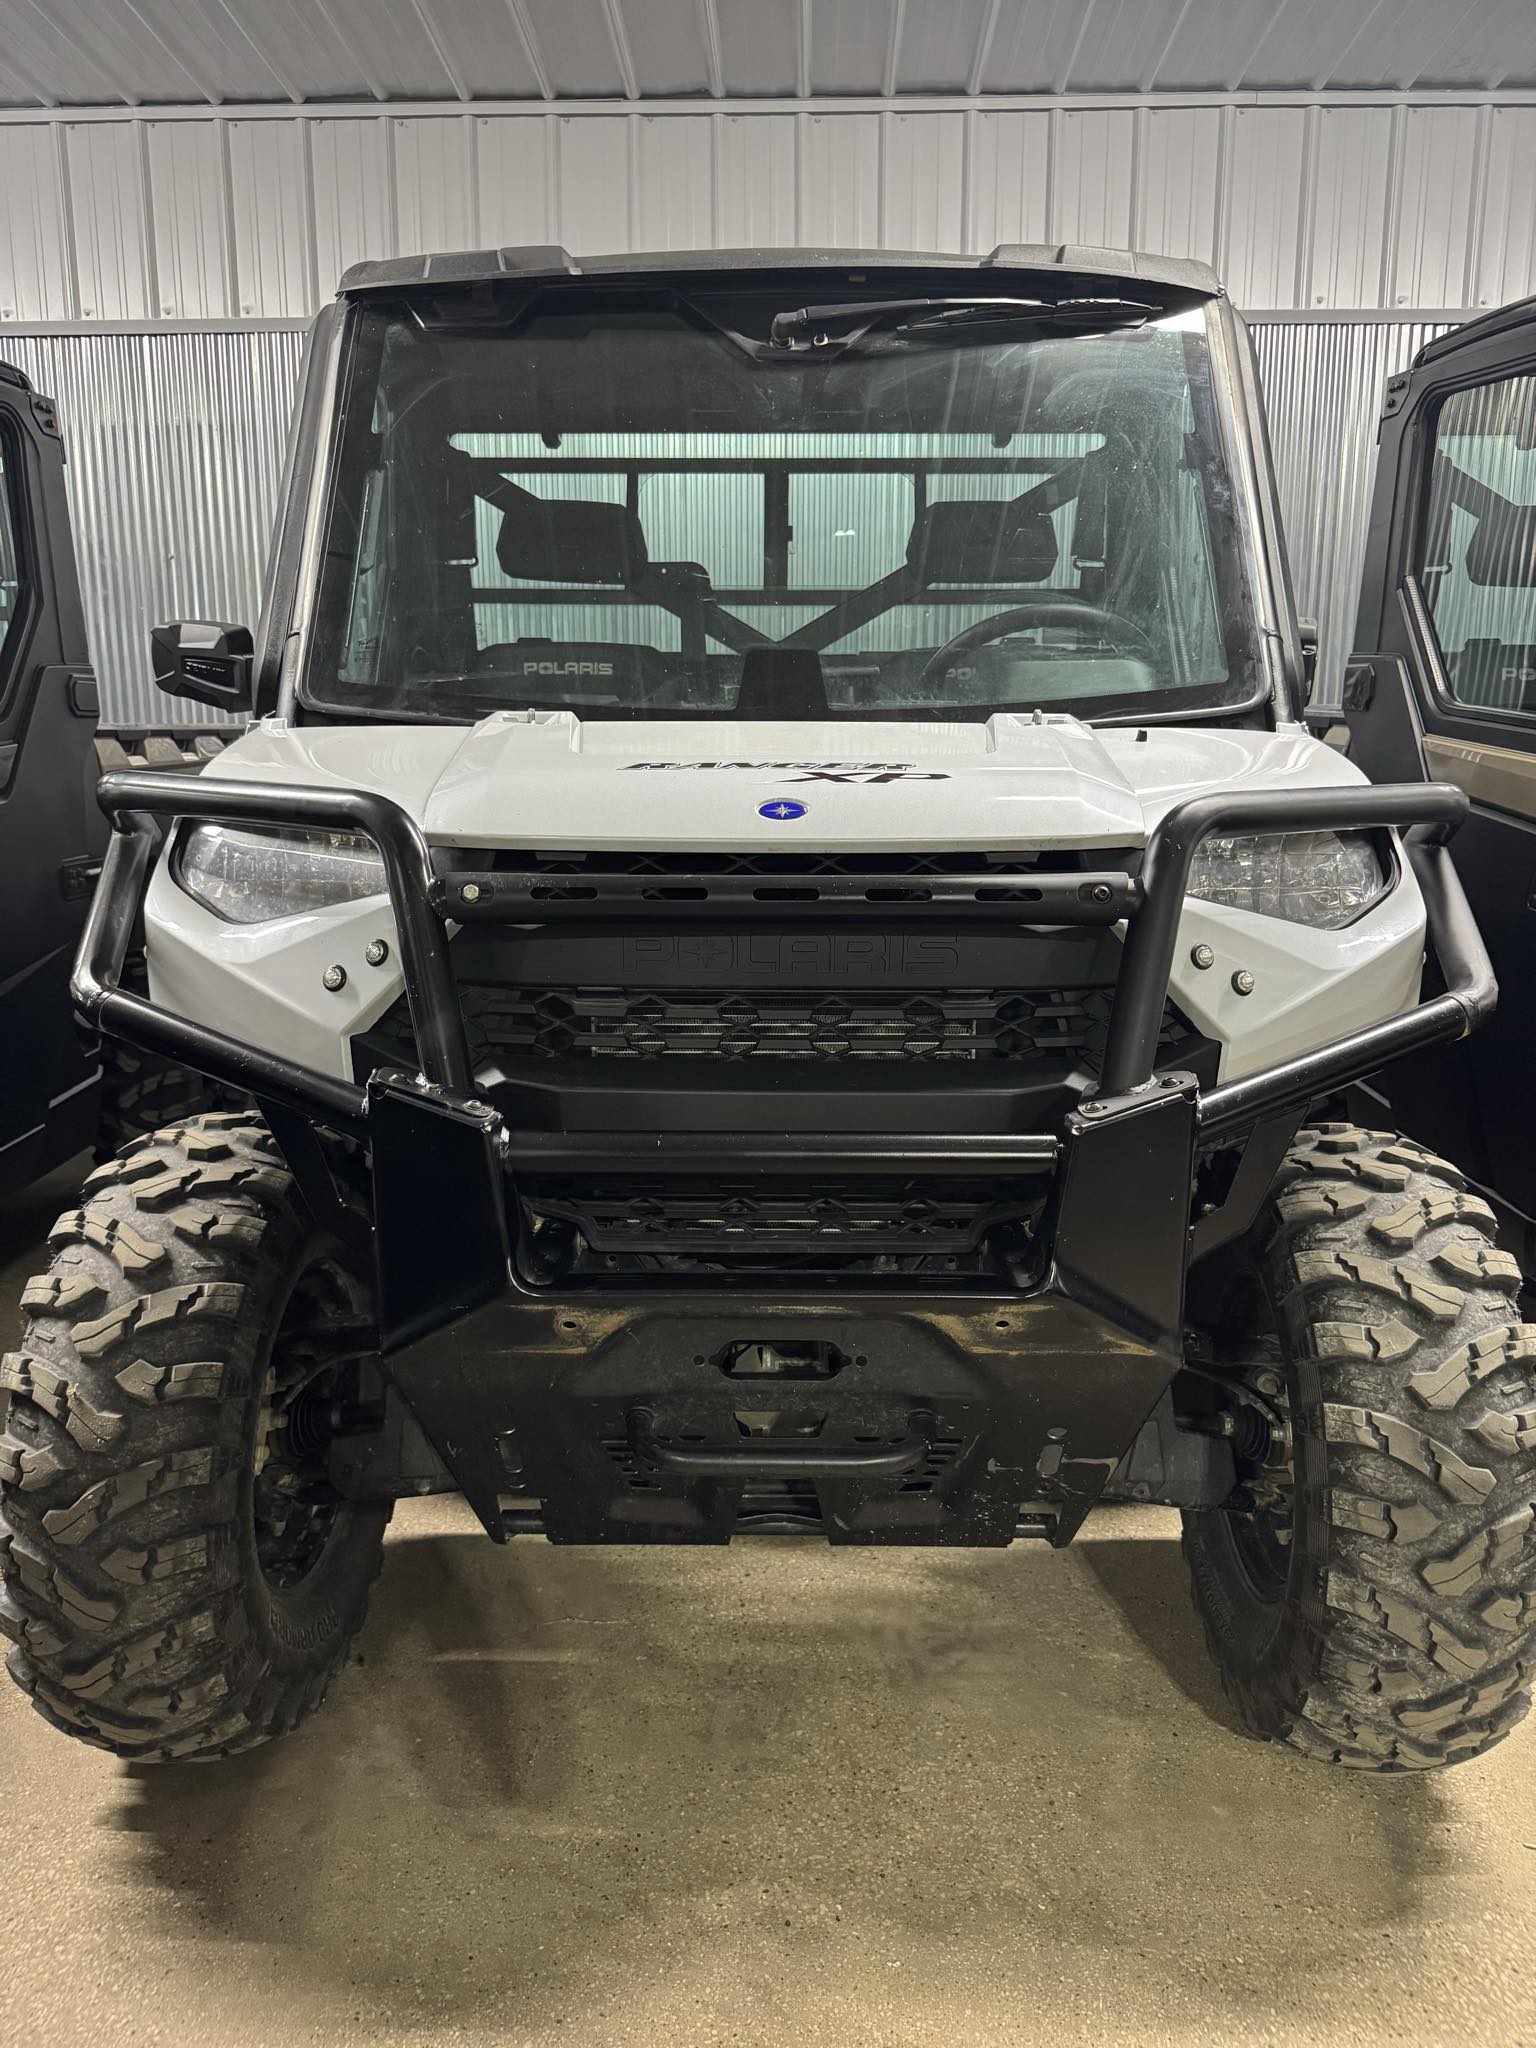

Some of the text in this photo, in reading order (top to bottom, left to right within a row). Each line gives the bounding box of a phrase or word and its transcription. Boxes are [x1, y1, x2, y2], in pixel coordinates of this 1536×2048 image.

[523, 662, 613, 675] POLARIS
[616, 762, 916, 771] RANGER
[772, 771, 953, 784] XP
[622, 934, 959, 974] POLARIS
